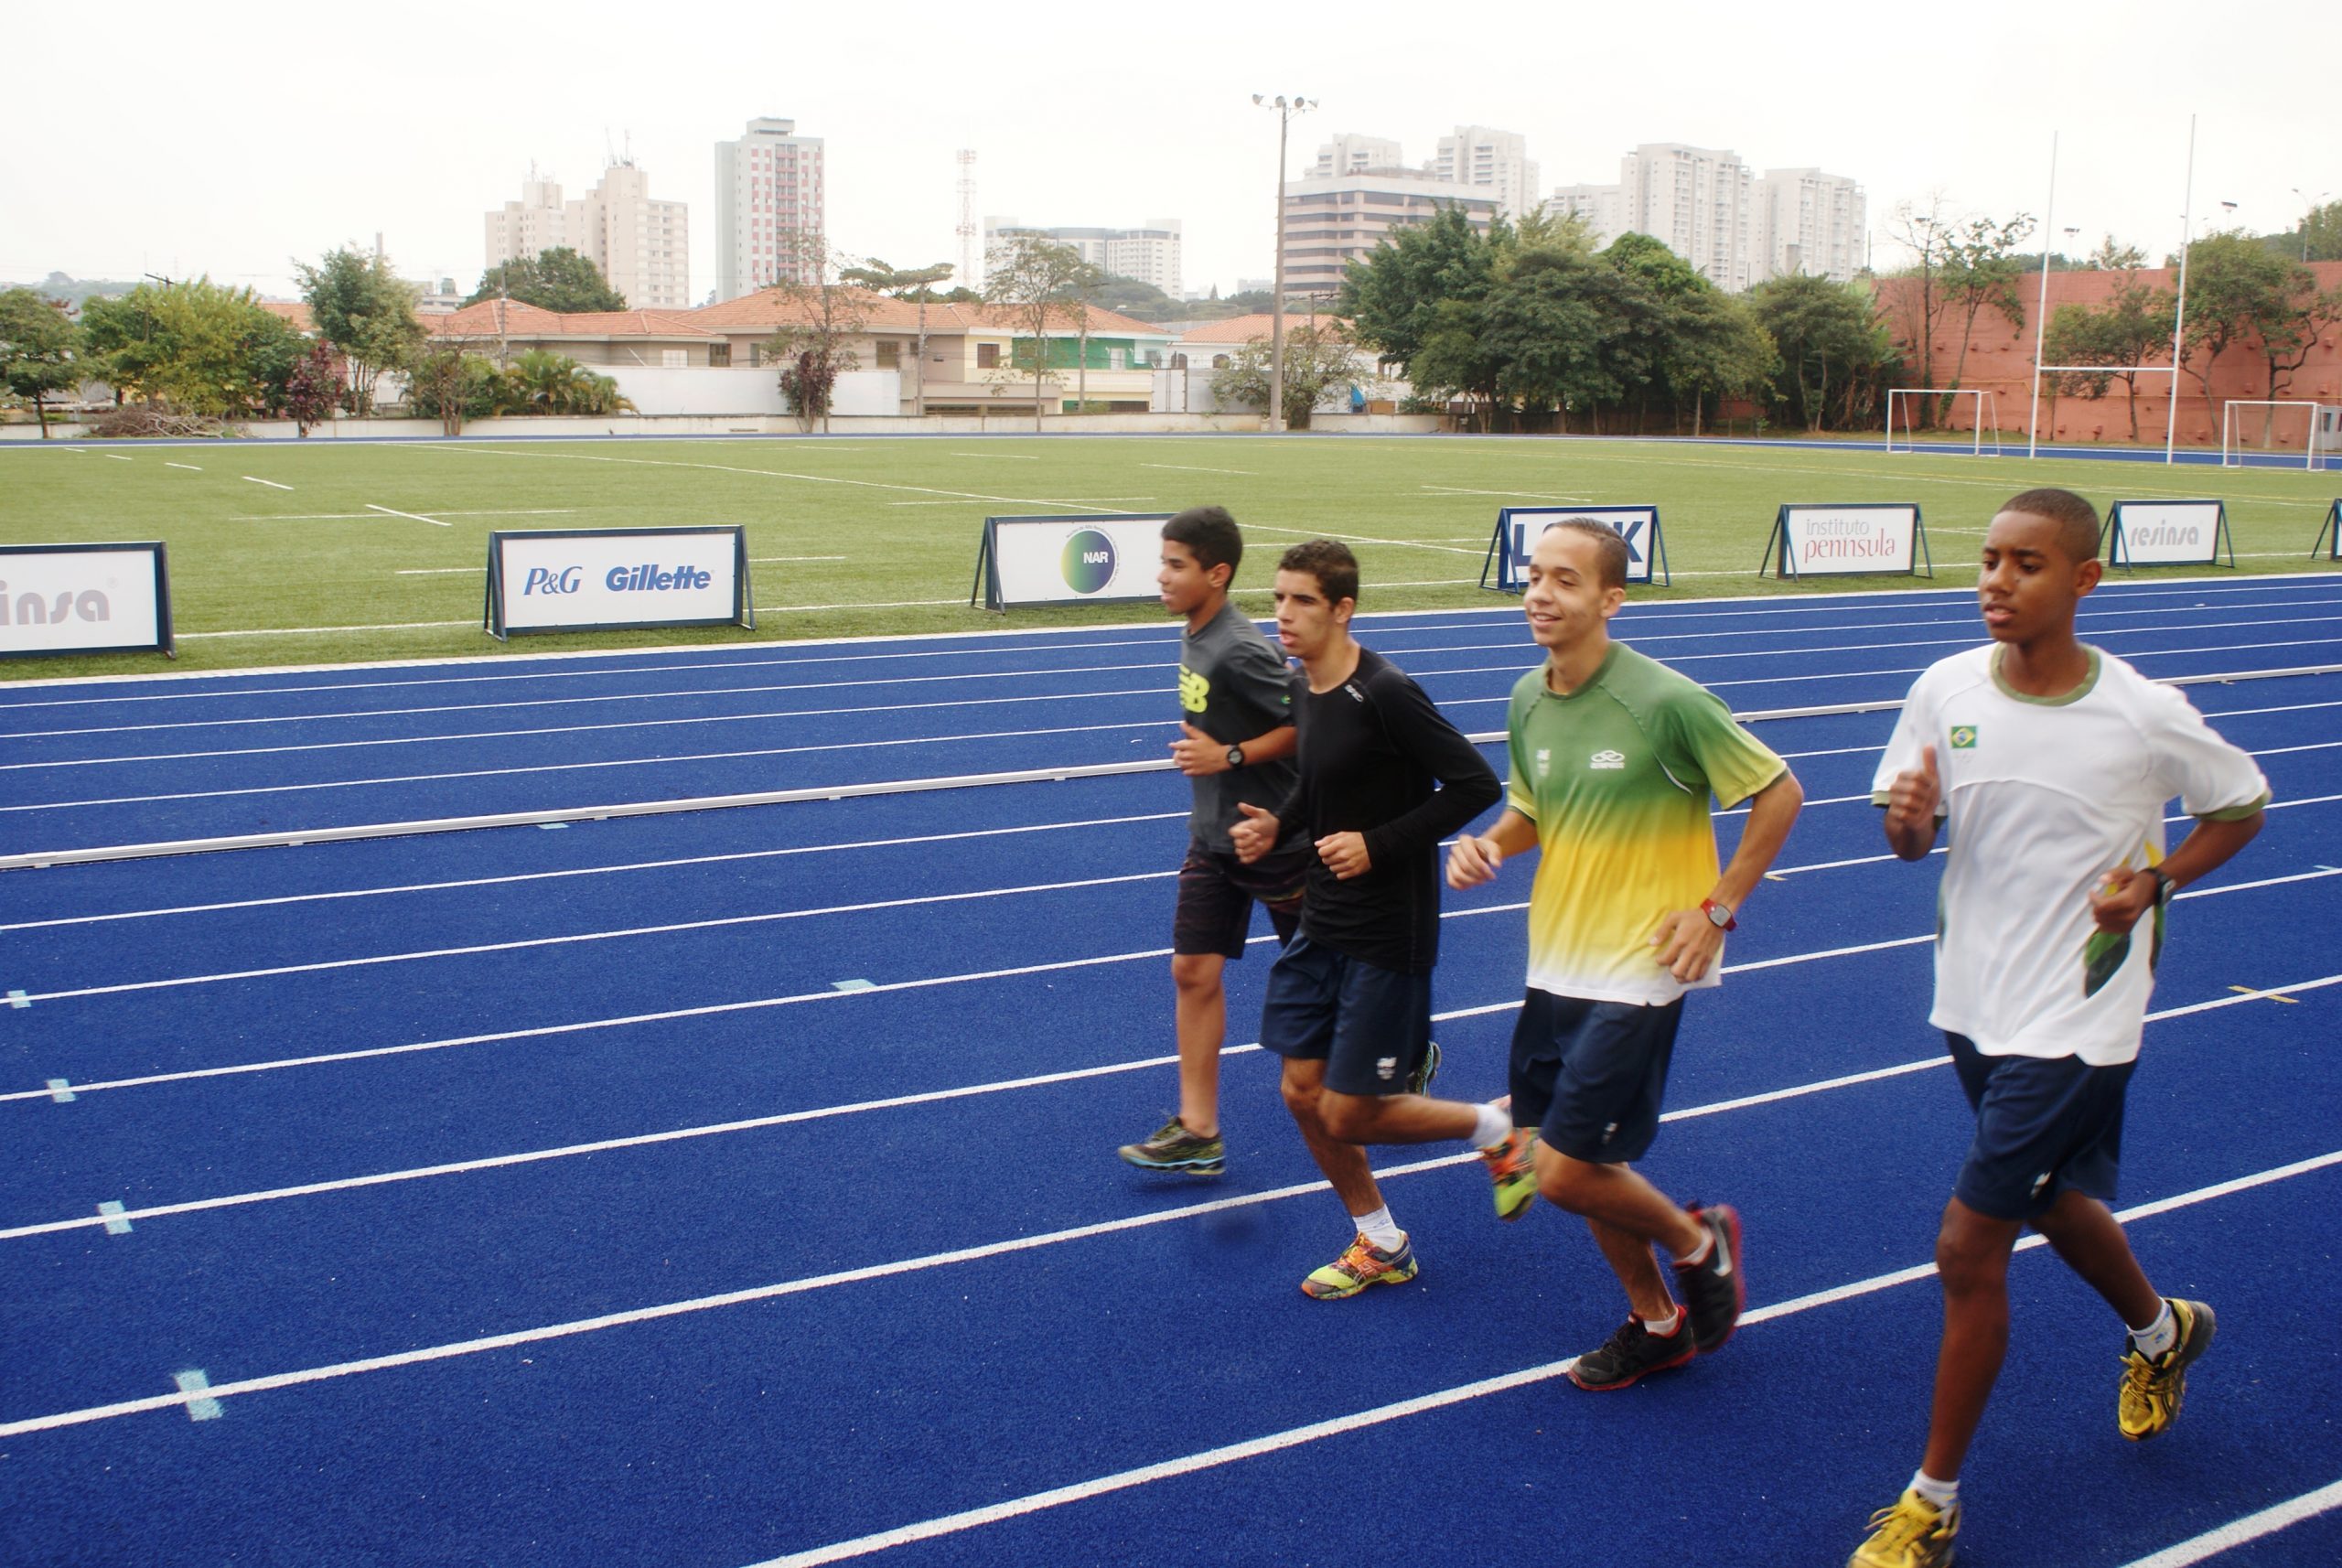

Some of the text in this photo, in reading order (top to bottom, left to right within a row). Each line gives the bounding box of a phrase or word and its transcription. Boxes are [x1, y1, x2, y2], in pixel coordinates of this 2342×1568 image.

[1806, 518, 1870, 536] instituto
[2129, 519, 2199, 547] resinsa
[1083, 551, 1109, 564] NAR
[1804, 527, 1896, 564] peninsula
[523, 564, 712, 596] P&G Gillette
